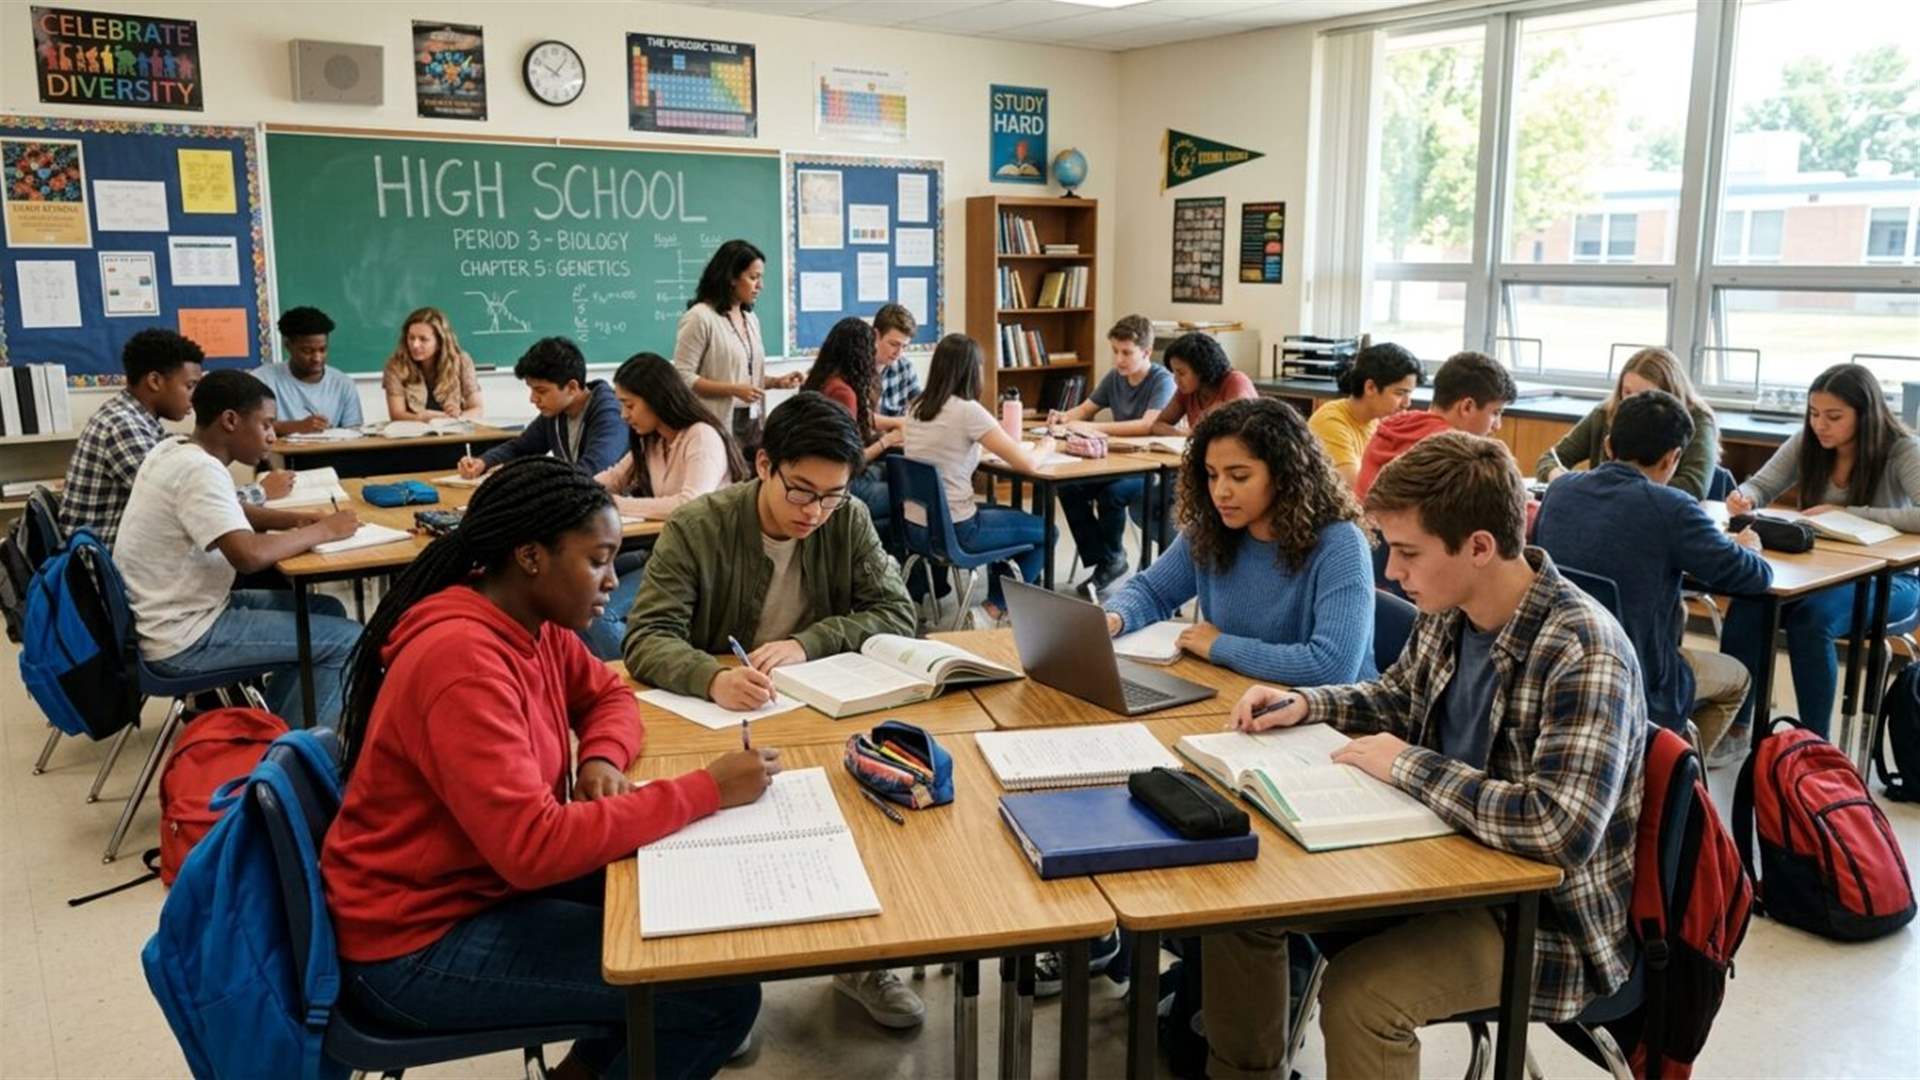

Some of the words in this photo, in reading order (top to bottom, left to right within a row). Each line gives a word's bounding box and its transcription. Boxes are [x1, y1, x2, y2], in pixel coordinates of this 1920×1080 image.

[40, 14, 192, 46] CELEBRATE
[47, 74, 194, 104] DIVERSITY
[994, 93, 1044, 113] STUDY
[994, 113, 1044, 135] HARD
[374, 155, 505, 218] HIGH
[531, 161, 708, 222] SCHOOL
[453, 228, 519, 250] PERIOD
[557, 229, 630, 252] BIOLOGY
[460, 259, 531, 277] CHAPTER
[556, 259, 631, 277] GENETICS
